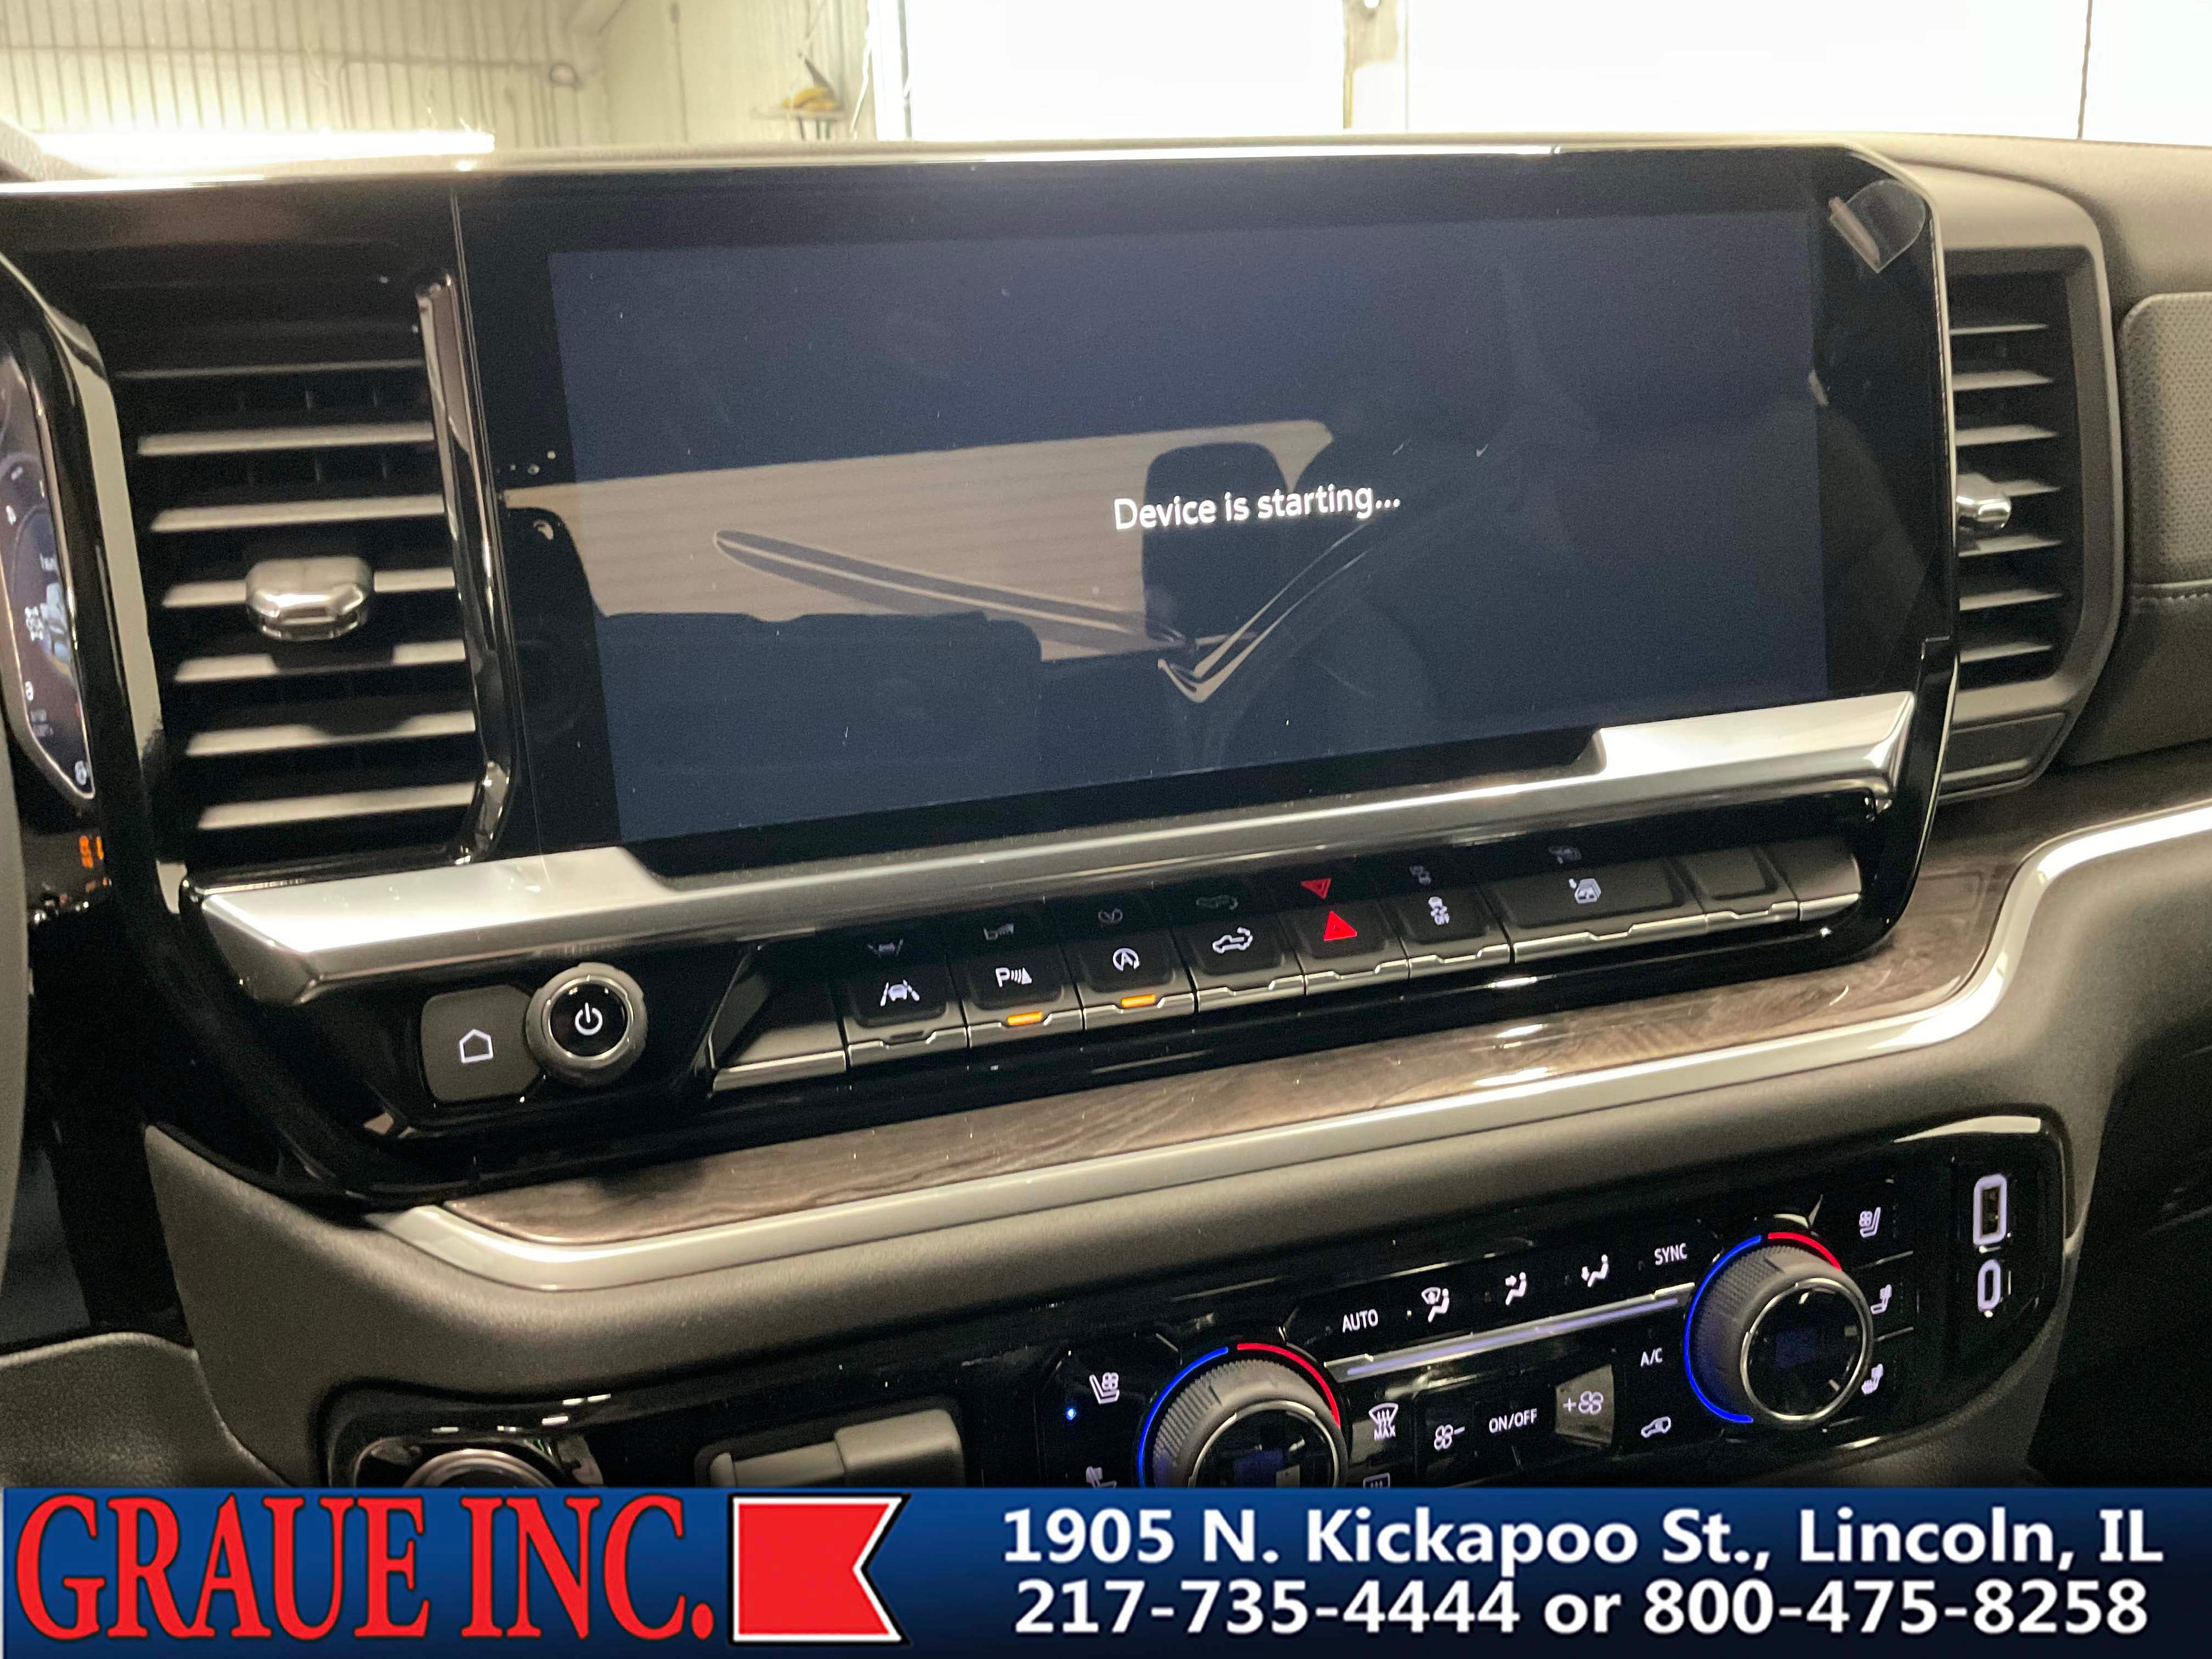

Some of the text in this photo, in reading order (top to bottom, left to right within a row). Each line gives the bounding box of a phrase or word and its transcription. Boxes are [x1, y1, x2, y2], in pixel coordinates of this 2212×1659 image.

[1114, 483, 1401, 530] Device is starting...
[1654, 1243, 1688, 1266] SYNC
[1342, 1308, 1379, 1333] AUTO
[1640, 1347, 1663, 1367] A/C
[1373, 1425, 1396, 1441] MAX
[1488, 1408, 1537, 1434] ON/OFF
